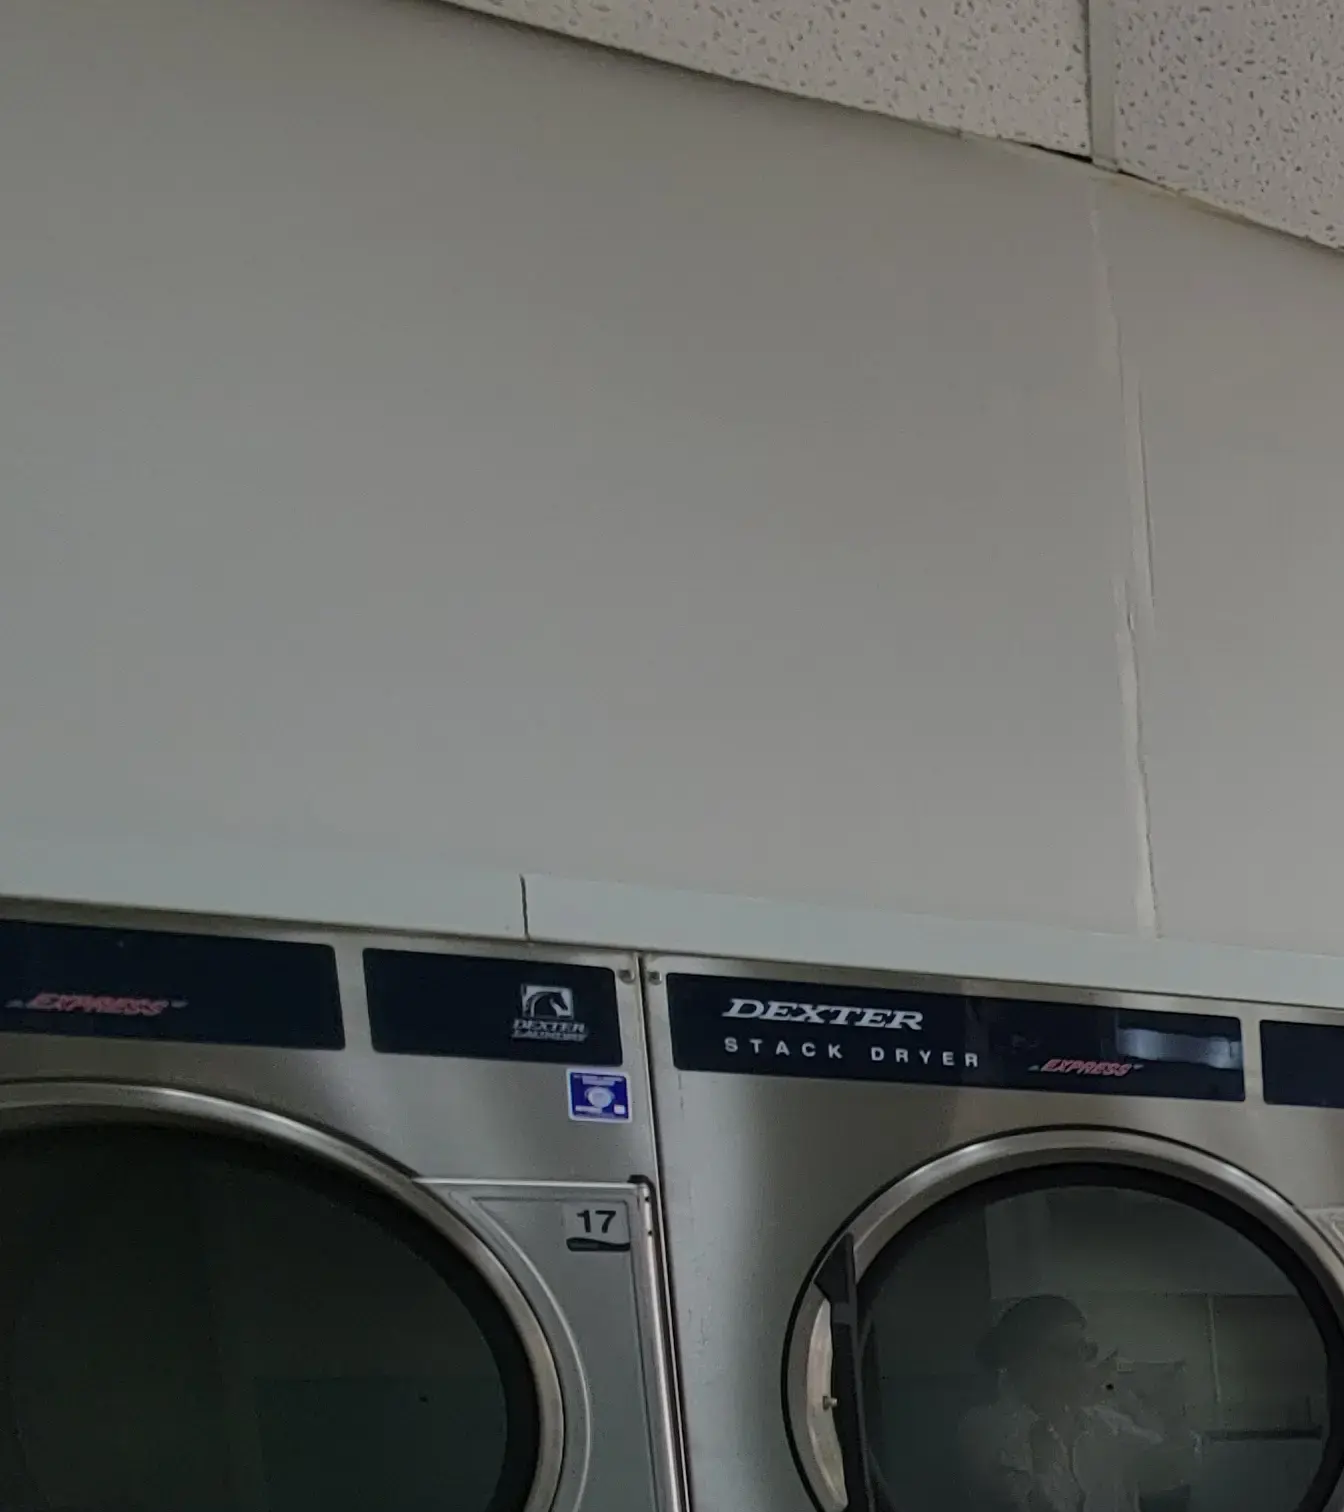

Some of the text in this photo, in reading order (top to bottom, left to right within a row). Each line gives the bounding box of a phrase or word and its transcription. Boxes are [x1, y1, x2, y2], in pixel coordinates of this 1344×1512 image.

[512, 1018, 586, 1034] DEXTER
[721, 998, 924, 1031] DEXTER
[724, 1036, 979, 1068] STACK DRYER
[1040, 1057, 1133, 1077] EXPRESS
[576, 1209, 617, 1234] 17
